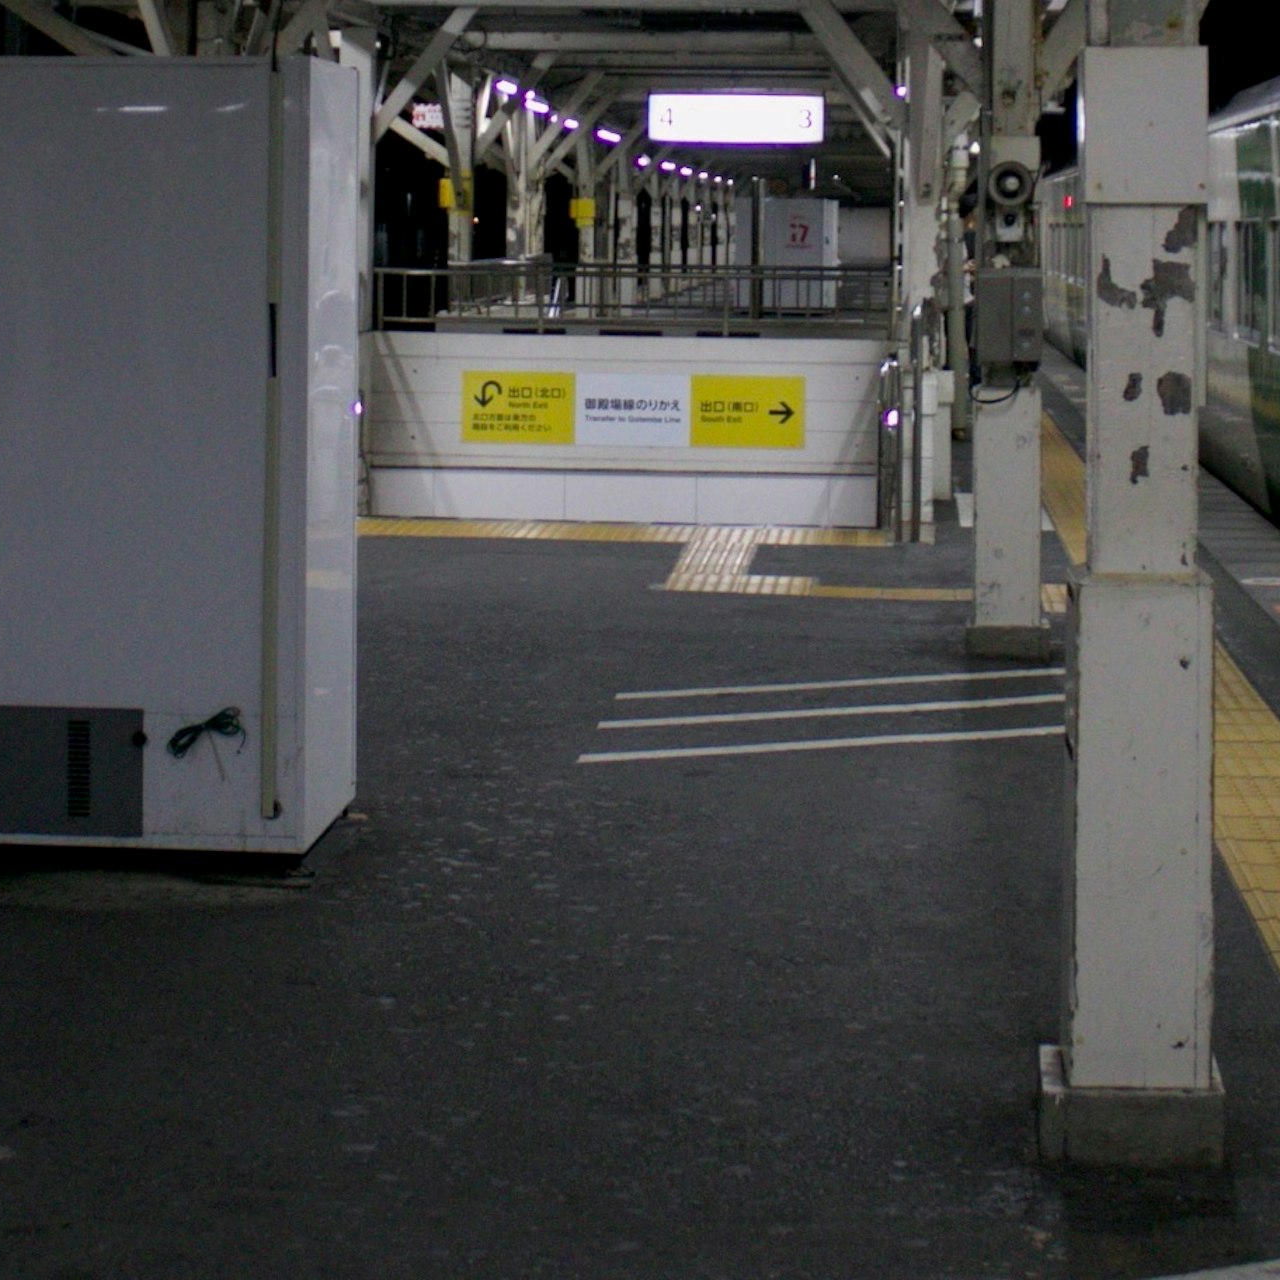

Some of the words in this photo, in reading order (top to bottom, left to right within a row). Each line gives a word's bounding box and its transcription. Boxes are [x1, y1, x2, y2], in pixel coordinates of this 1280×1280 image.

[659, 107, 673, 127] 4
[798, 108, 813, 130] 3
[584, 397, 682, 412] 御殿場線のりかえ
